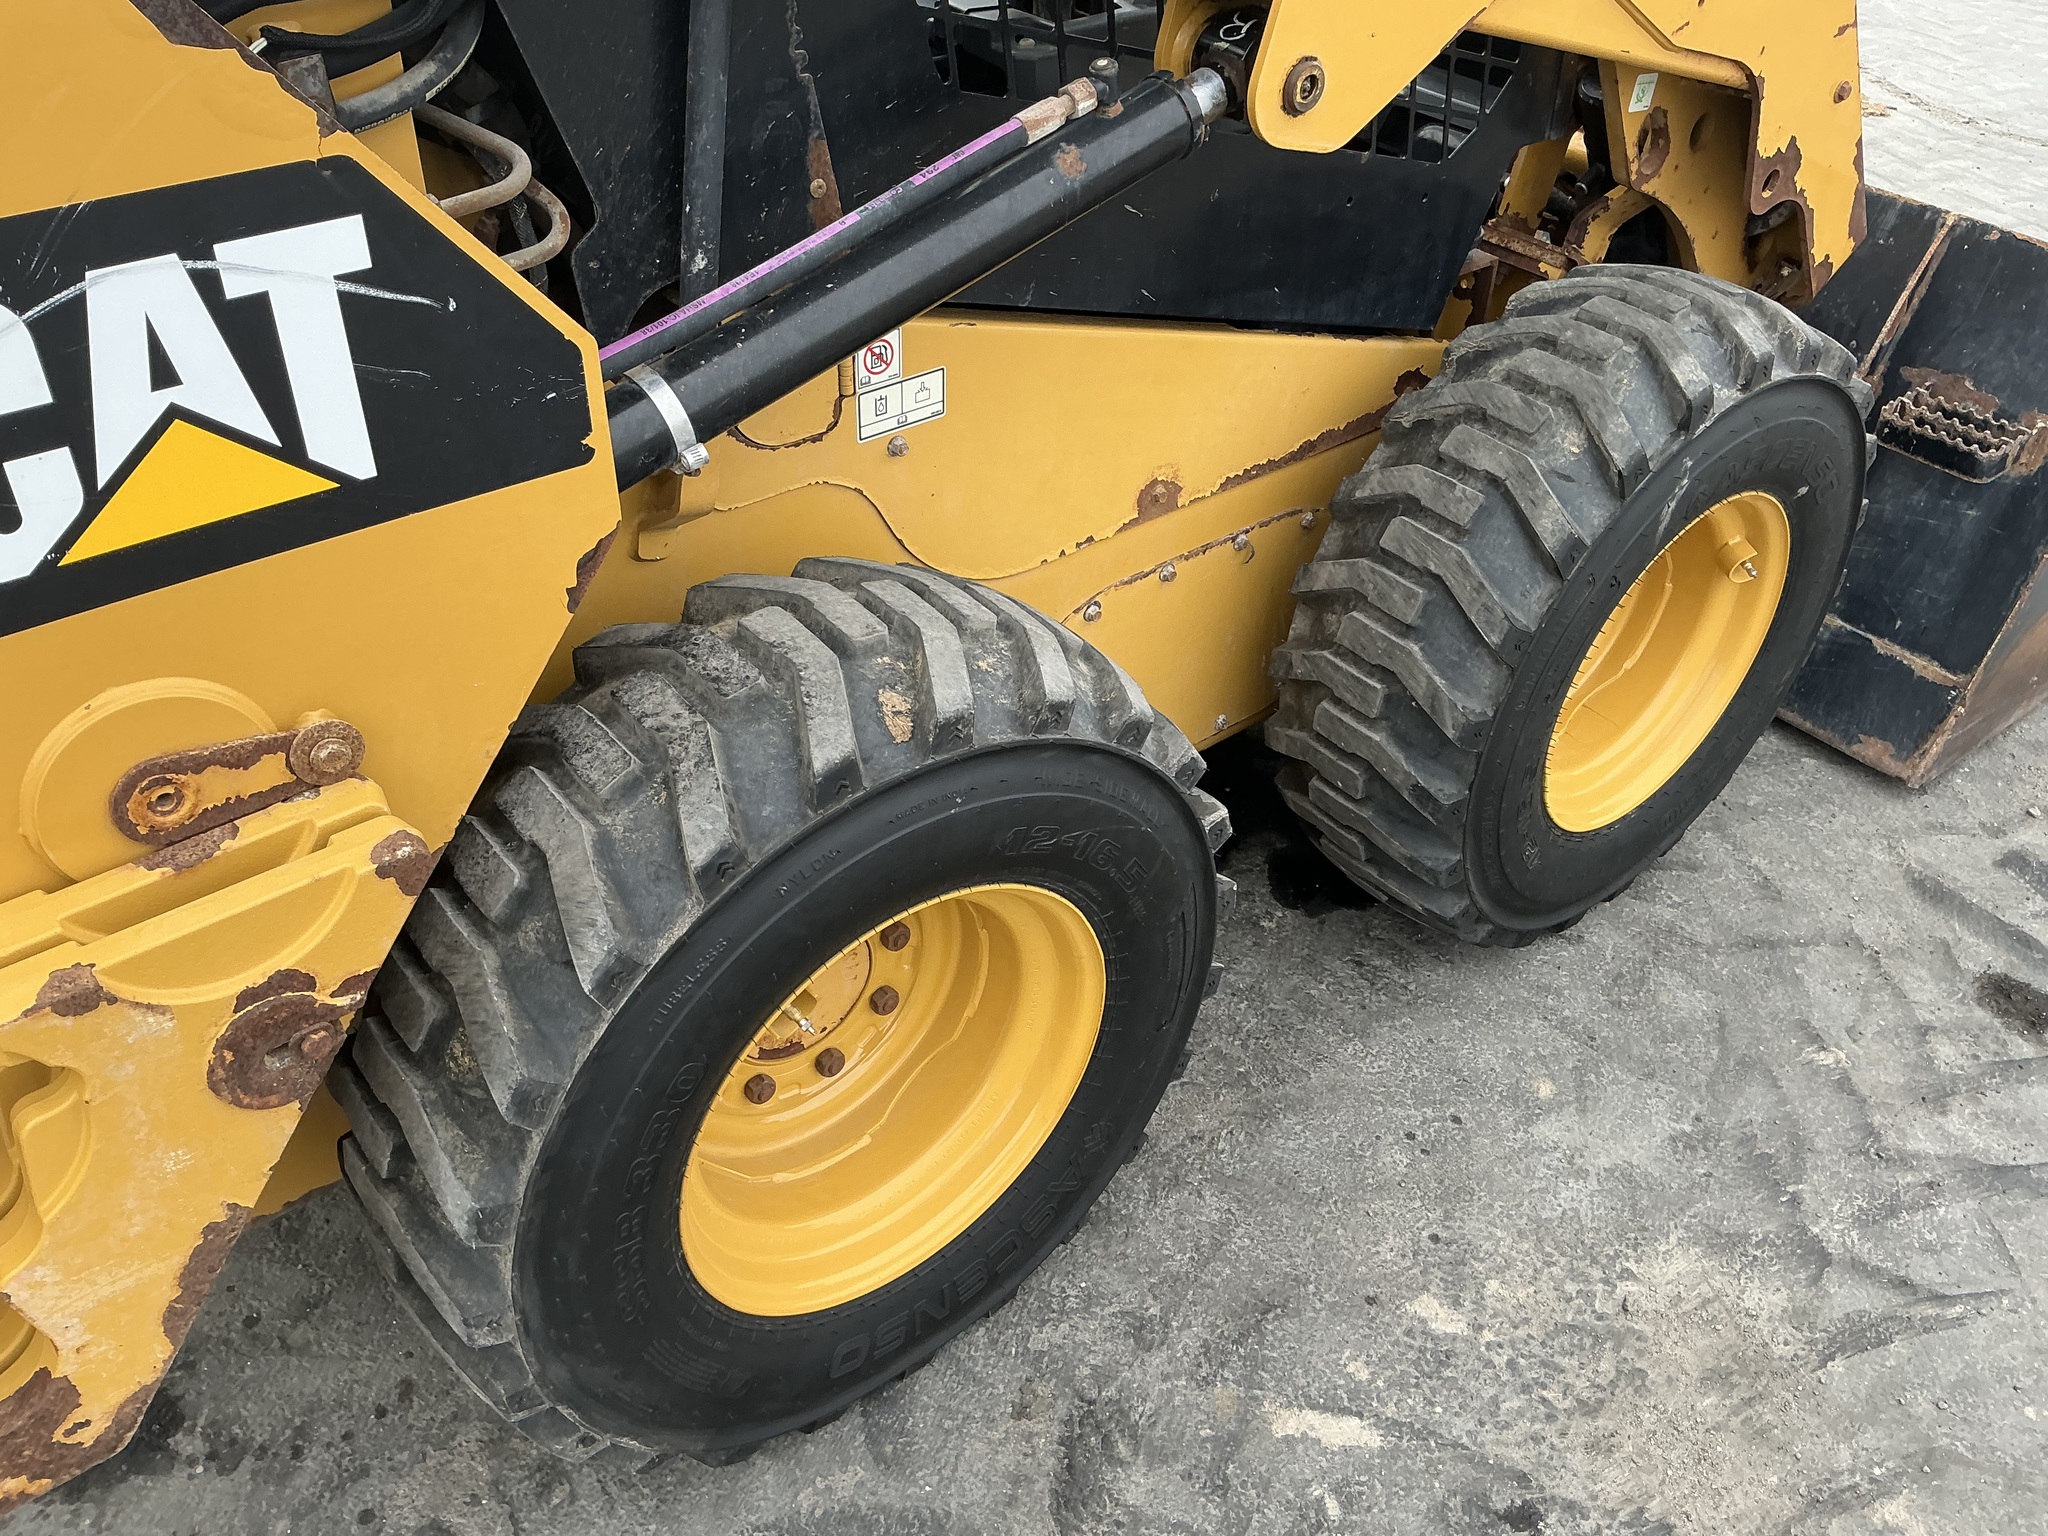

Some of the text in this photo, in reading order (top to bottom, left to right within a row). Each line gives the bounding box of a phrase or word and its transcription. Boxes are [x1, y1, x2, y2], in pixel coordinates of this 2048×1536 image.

[895, 802, 924, 821] MADE
[927, 797, 938, 806] IN
[774, 848, 837, 897] NYLON
[649, 937, 726, 1023] TUBELESS
[829, 1152, 1086, 1380] ASCENSO
